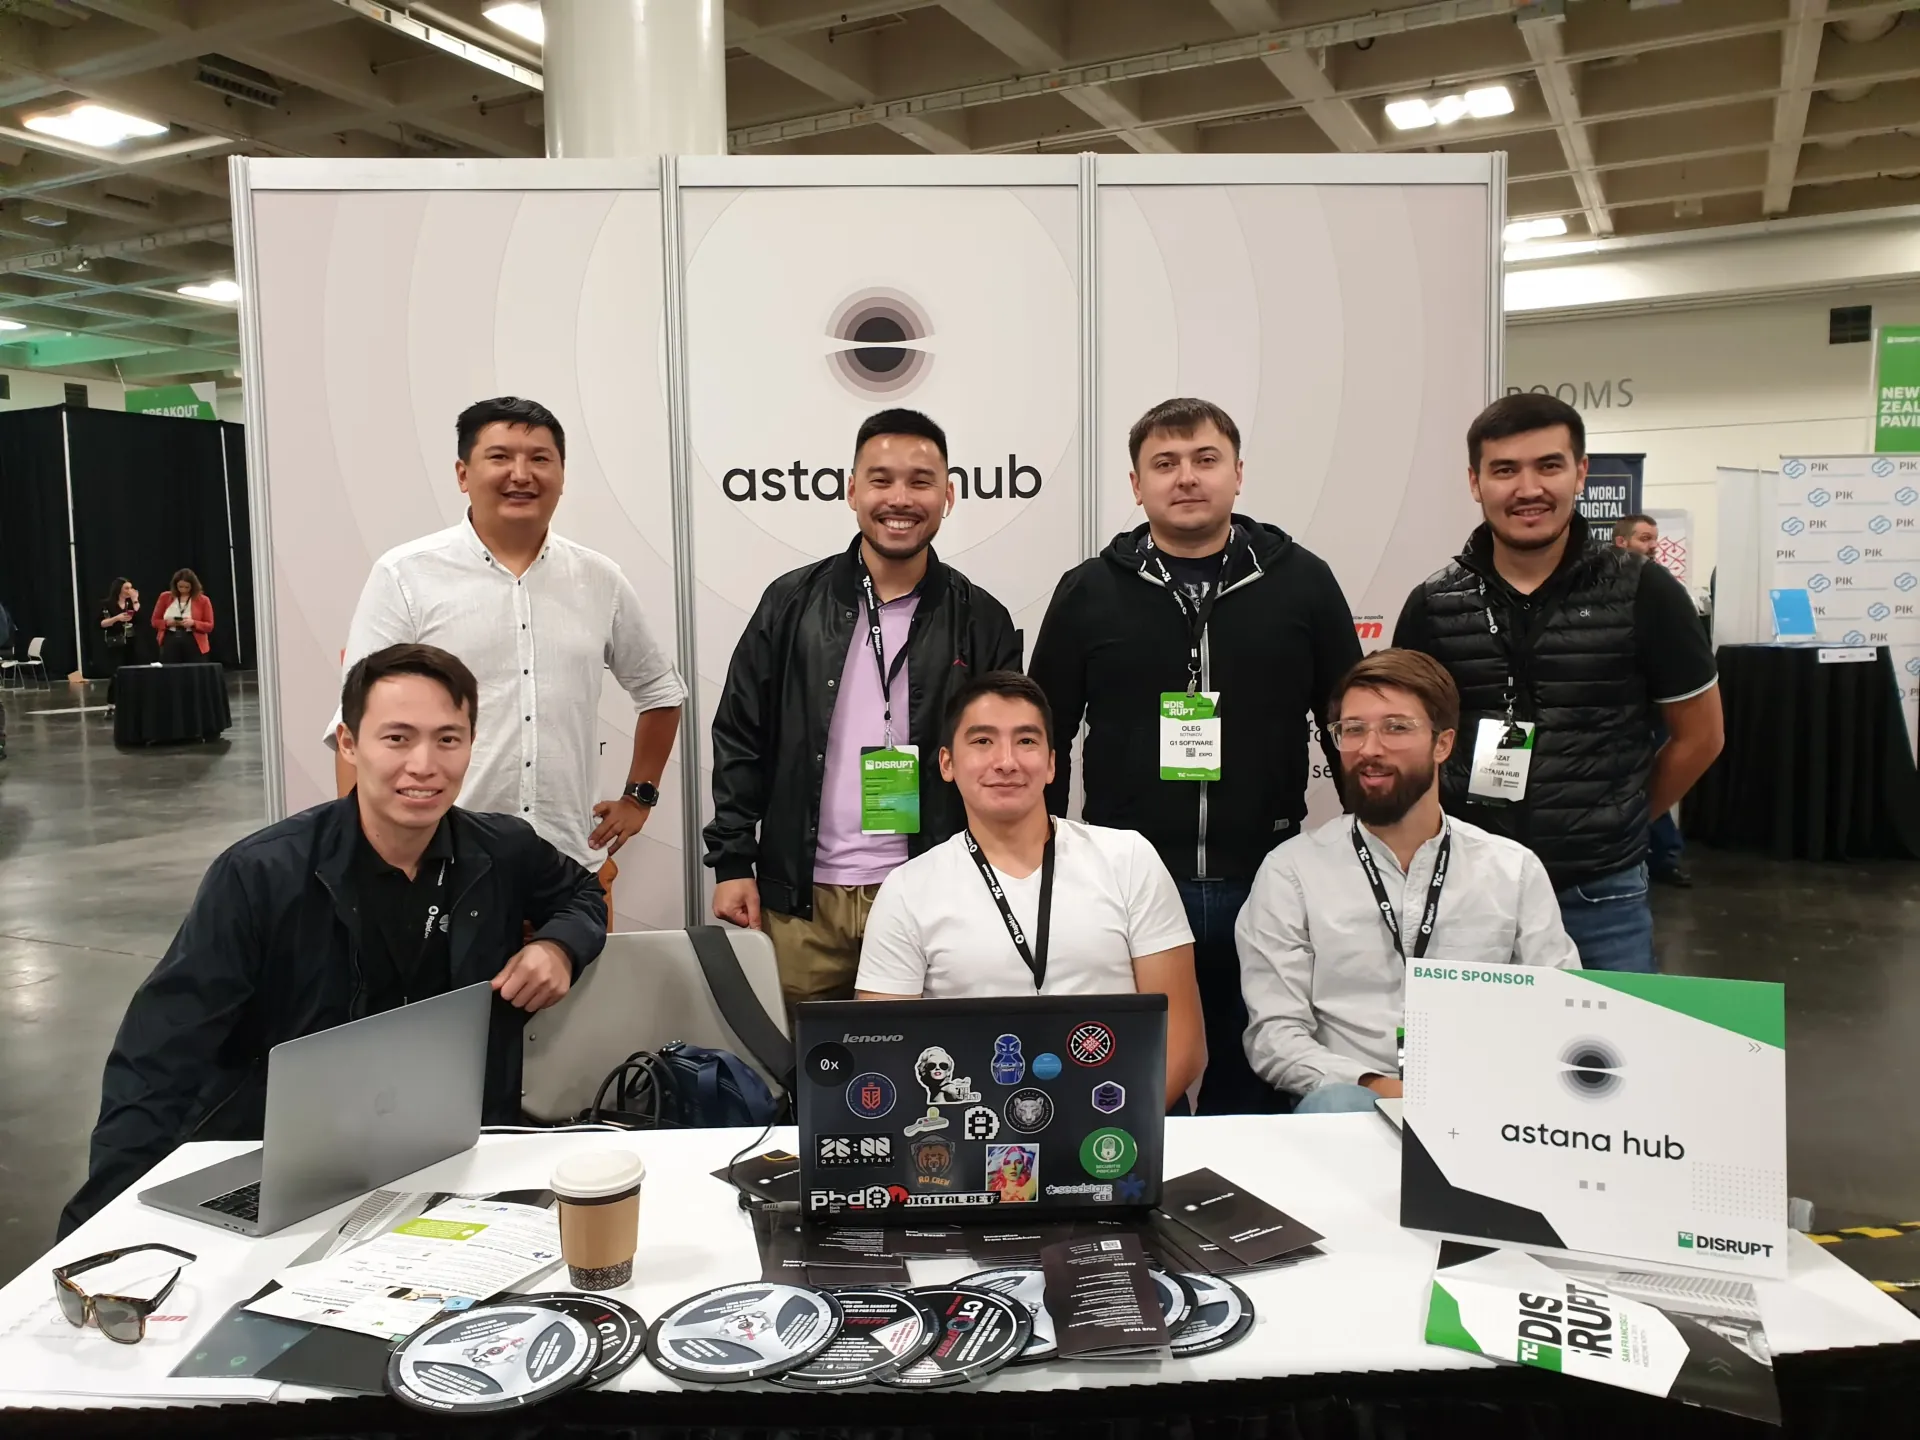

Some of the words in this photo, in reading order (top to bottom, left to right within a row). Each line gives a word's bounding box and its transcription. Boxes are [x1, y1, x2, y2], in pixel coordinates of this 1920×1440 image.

[1882, 387, 1920, 399] NEW
[1881, 401, 1920, 413] ZEAL
[1880, 415, 1920, 427] PAVI
[1811, 463, 1828, 471] PIK
[1900, 461, 1917, 470] PIK
[722, 460, 853, 501] asta
[1589, 486, 1626, 500] WORLD
[1835, 491, 1853, 499] PIK
[1580, 502, 1625, 518] DIGITAL
[1809, 520, 1827, 528] PIK
[1896, 518, 1914, 527] PIK
[1777, 550, 1795, 558] PIK
[1865, 548, 1883, 557] PIK
[1835, 577, 1853, 585] PIK
[1895, 605, 1913, 614] PIK
[1870, 633, 1888, 642] PIK
[874, 760, 914, 769] DISRUPT
[1414, 966, 1458, 981] BASIC
[1461, 970, 1535, 986] SPONSOR
[842, 1033, 904, 1044] lenovo
[820, 1058, 839, 1071] 0x
[1501, 1123, 1611, 1152] astana
[1623, 1130, 1685, 1160] hub
[821, 1157, 891, 1165] QAZAQSTAN
[932, 1176, 951, 1186] CREW
[1058, 1183, 1113, 1194] seedstars
[907, 1195, 960, 1206] DIGITAL
[1679, 1232, 1692, 1240] TC
[1696, 1235, 1774, 1258] DISRUPT
[1518, 1291, 1563, 1346] DIS
[1566, 1283, 1613, 1359] RUPT
[1521, 1340, 1538, 1364] TC
